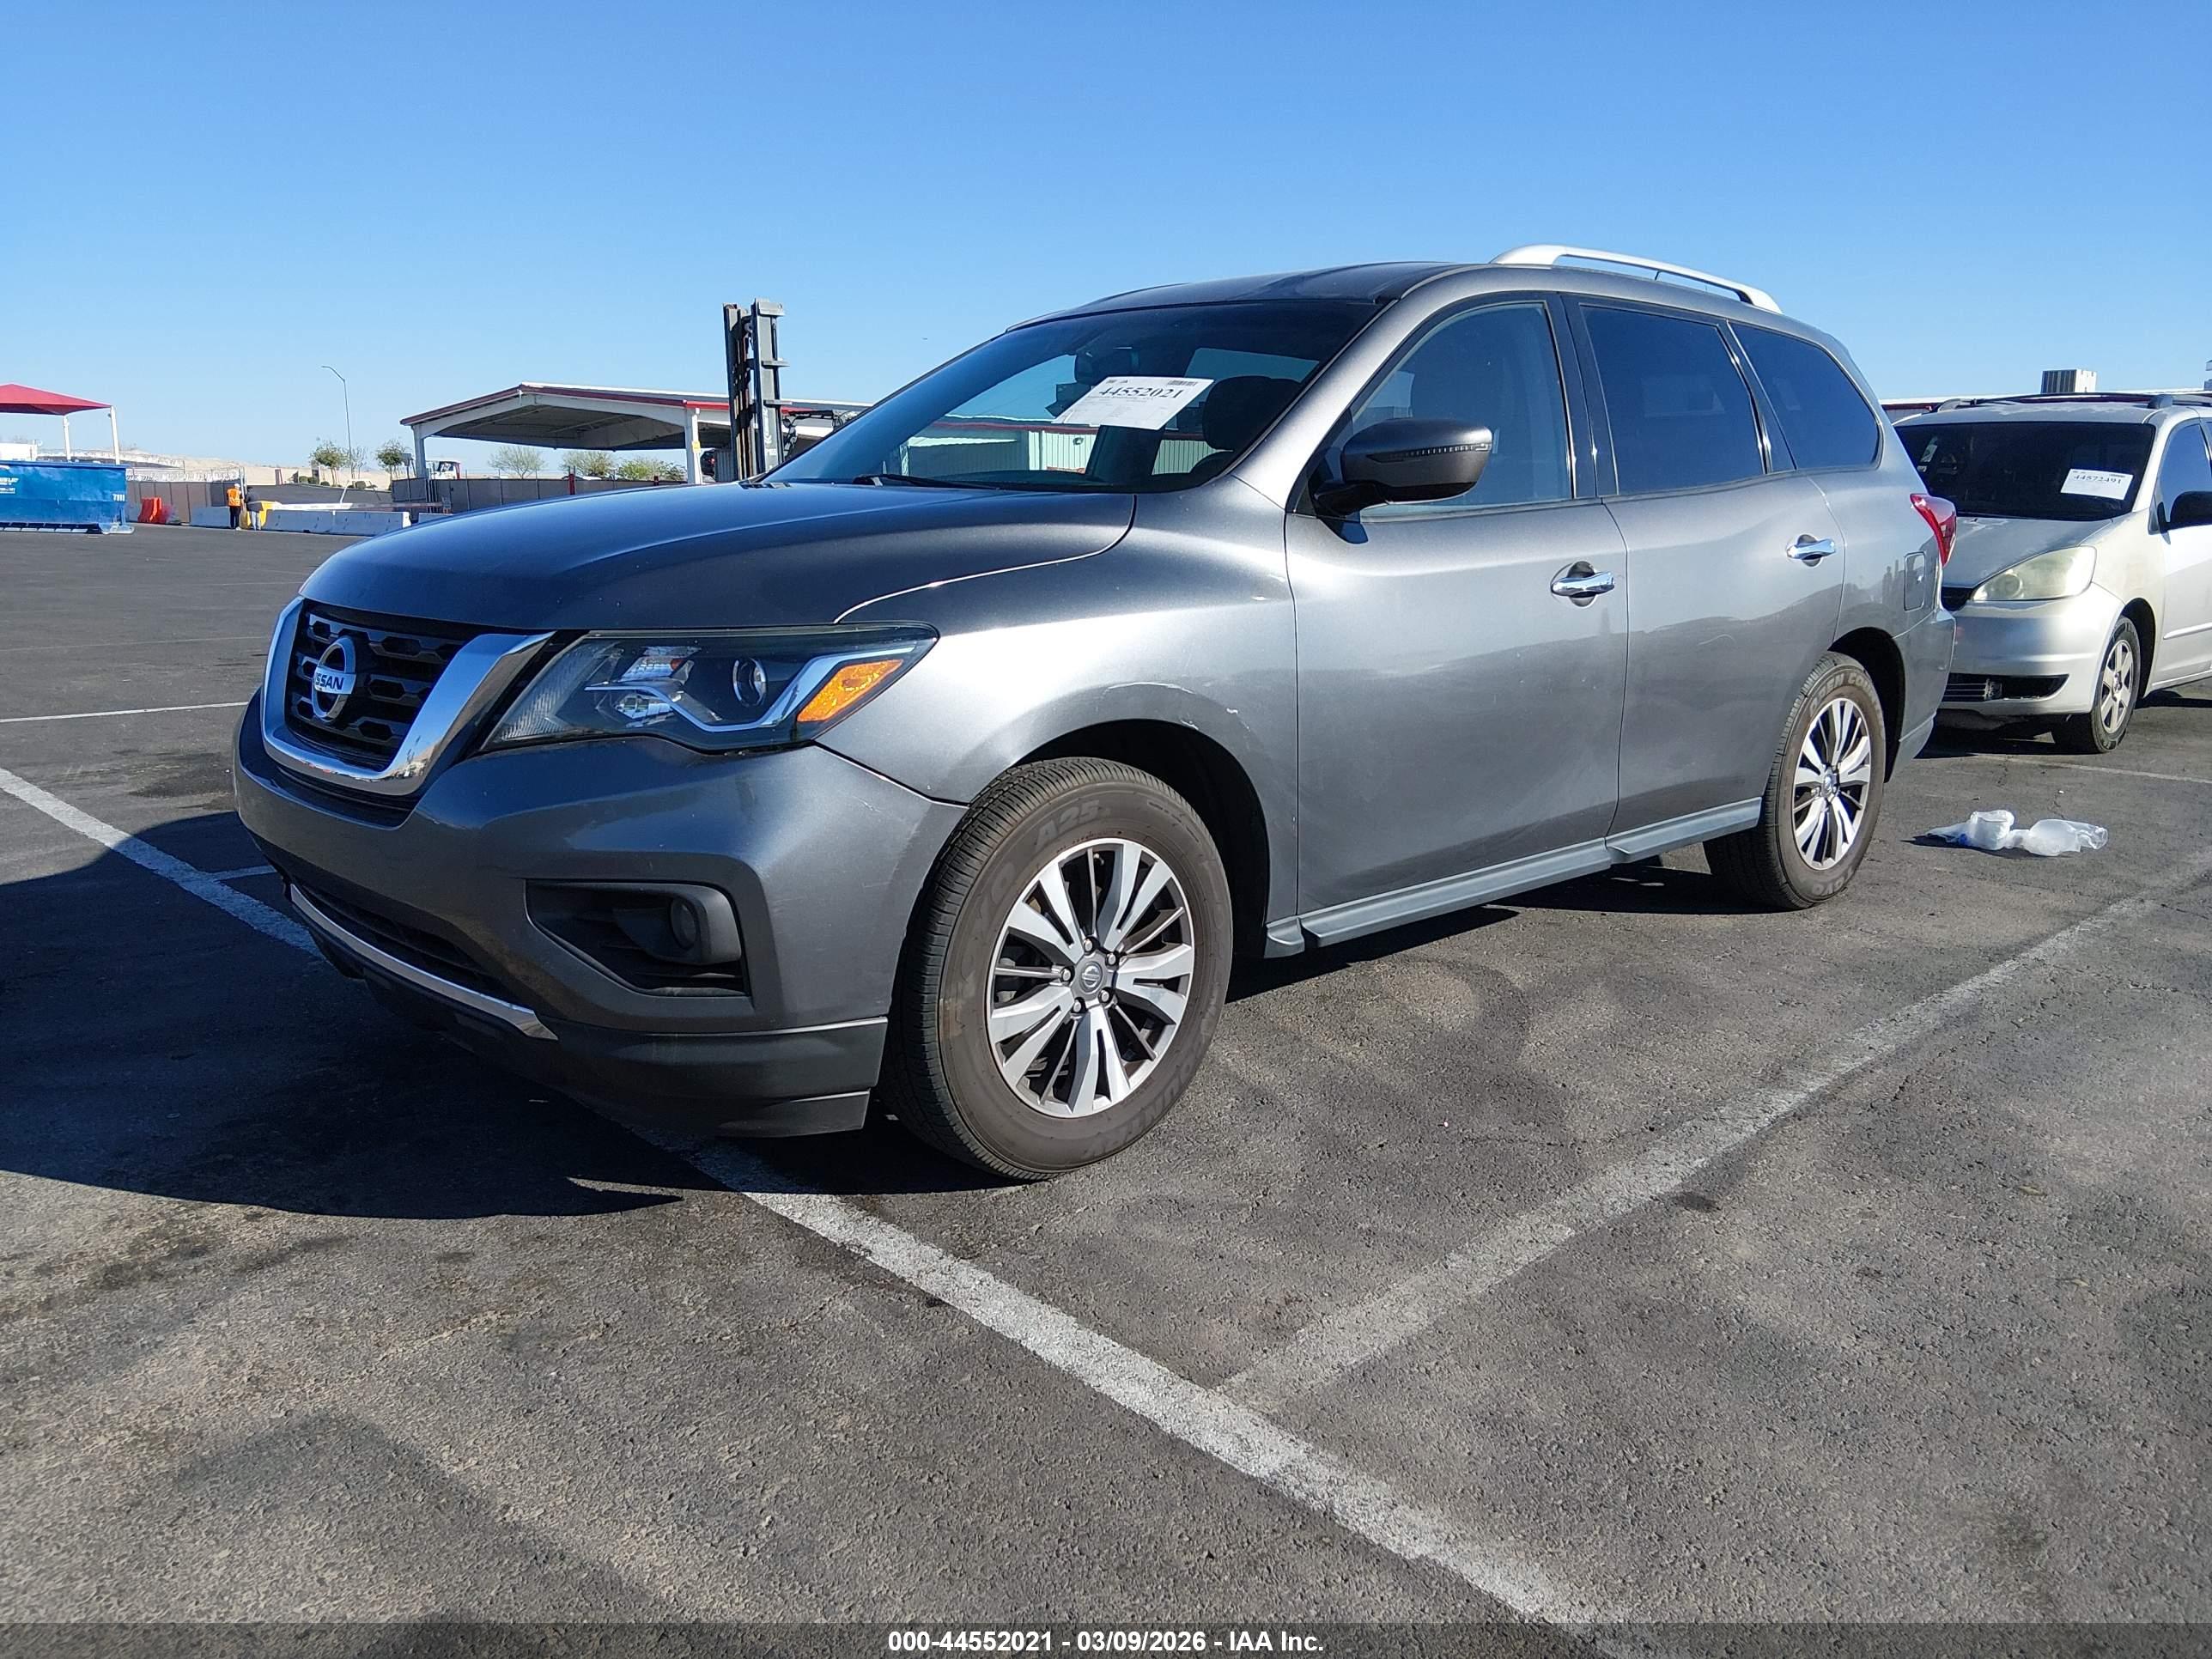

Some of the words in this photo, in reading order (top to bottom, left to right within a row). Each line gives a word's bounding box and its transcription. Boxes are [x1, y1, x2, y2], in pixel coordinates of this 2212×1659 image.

[1098, 386, 1185, 398] 44552021
[2074, 475, 2122, 484] 44572491
[316, 672, 343, 690] SSAN
[1035, 799, 1100, 848] A25
